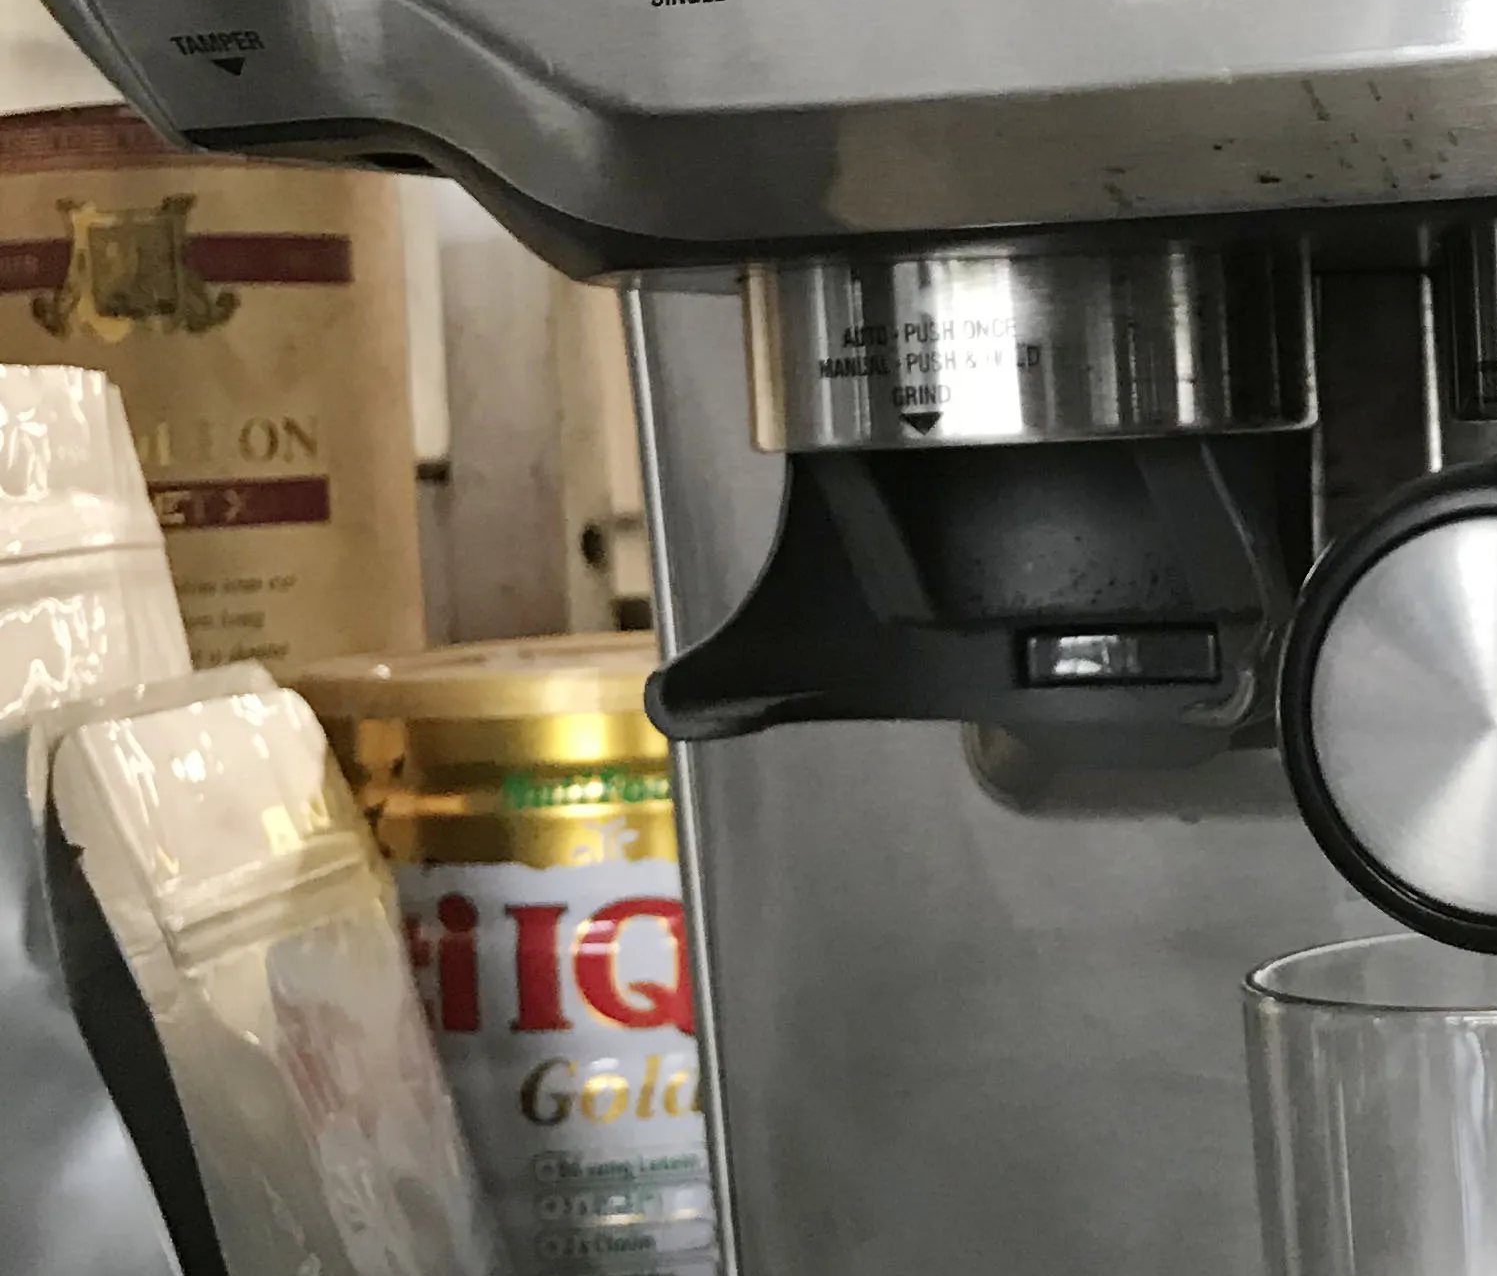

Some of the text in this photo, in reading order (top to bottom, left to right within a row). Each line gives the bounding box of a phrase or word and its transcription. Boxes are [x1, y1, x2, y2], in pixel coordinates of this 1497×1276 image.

[169, 31, 266, 56] TAMPER
[904, 321, 955, 344] PUSH
[906, 351, 957, 373] PUSH
[892, 384, 951, 408] GRIND
